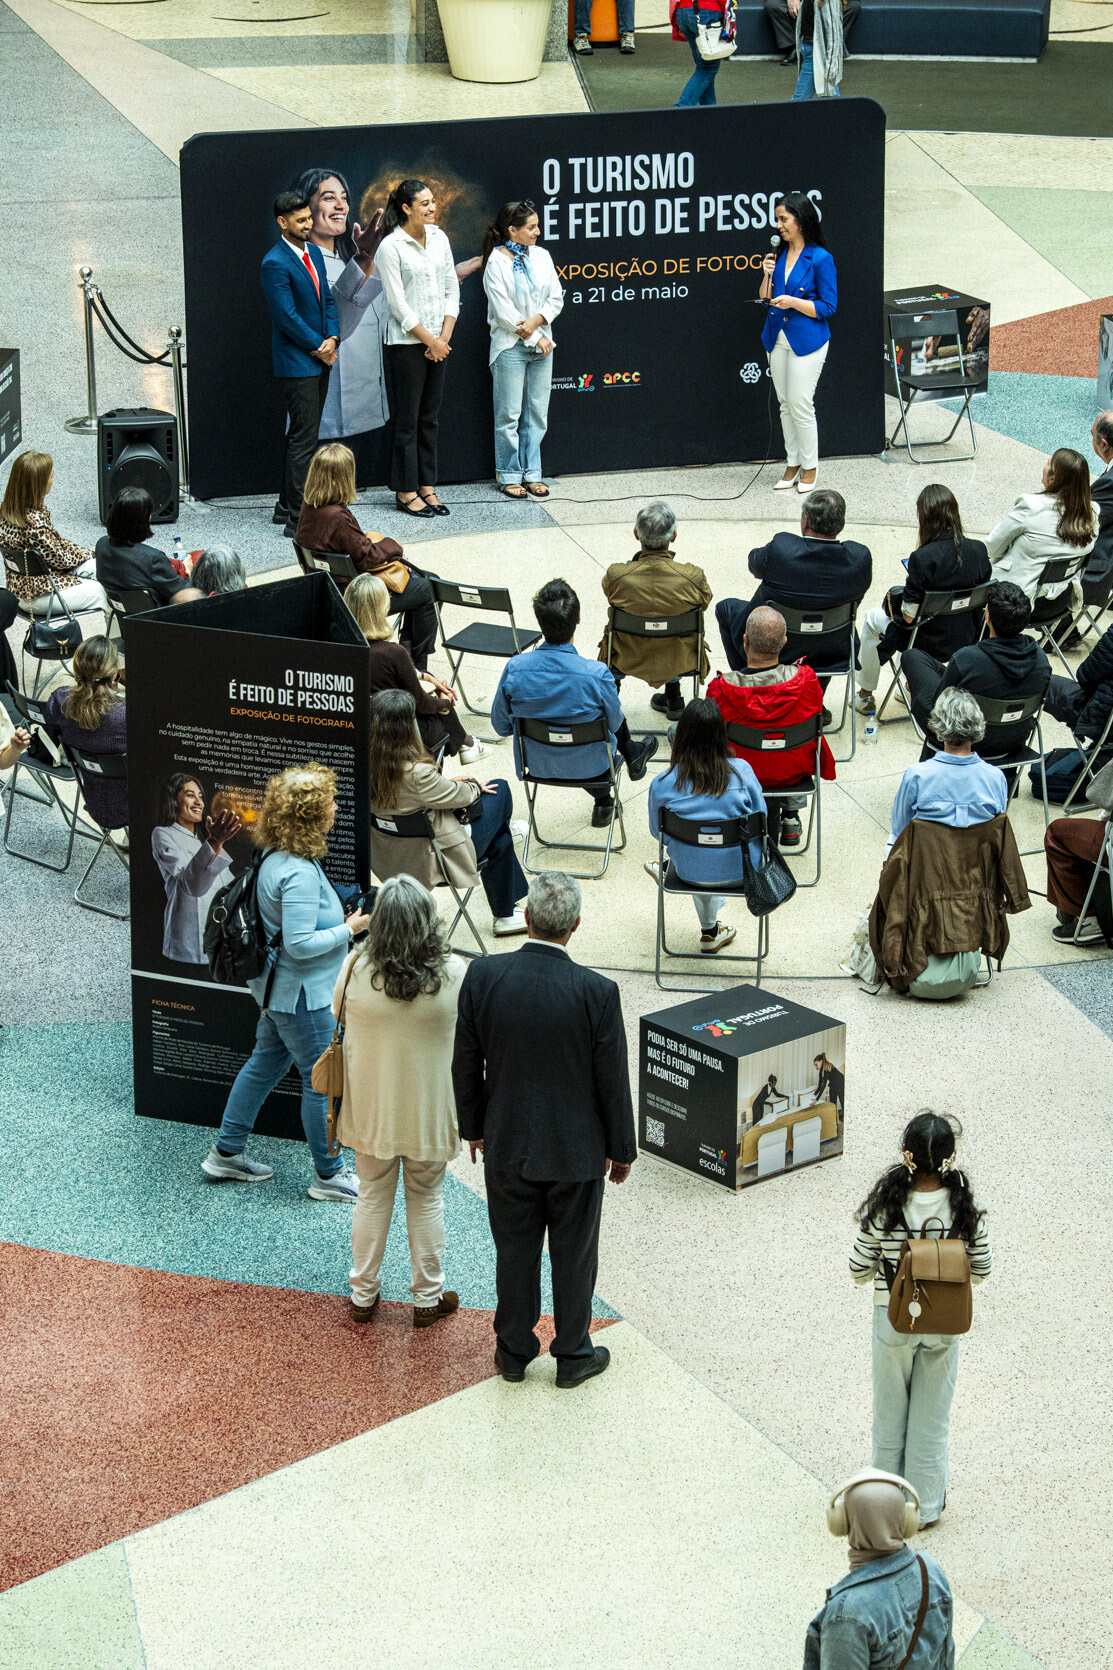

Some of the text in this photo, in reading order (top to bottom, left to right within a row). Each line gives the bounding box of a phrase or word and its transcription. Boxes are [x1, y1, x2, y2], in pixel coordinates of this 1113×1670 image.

[542, 152, 695, 196] O TURISMO
[543, 190, 822, 240] É FEITO DE PESSOS
[556, 254, 762, 280] XPOSIÇÃO DE FOTOG
[572, 292, 582, 304] a
[588, 287, 605, 303] 21
[611, 286, 636, 301] de
[641, 282, 688, 300] maio
[285, 669, 354, 693] O TURISMO
[229, 679, 354, 713] É FEITO DE PESSOAS
[172, 723, 214, 734] hospitalidade
[230, 707, 354, 729] EXPOSIÇÃO DE FOTOGRAFIA
[168, 730, 193, 739] cuidado
[232, 739, 258, 748] empatia
[333, 750, 355, 759] acolhe
[188, 757, 218, 766] exposição
[241, 763, 281, 773] homenagem
[209, 750, 240, 759] memórias
[255, 756, 281, 765] levamos
[286, 752, 314, 761] subtileza
[214, 767, 246, 776] verdadeira
[726, 1004, 784, 1023] PORTUGAL
[648, 1030, 665, 1047] PODIA
[666, 1038, 678, 1052] SER
[679, 1043, 687, 1056] SÓ
[688, 1048, 701, 1063] UMA
[647, 1046, 695, 1076] MAS É O FUTURO
[647, 1062, 689, 1090] A ACONTECER!
[699, 1158, 726, 1176] escolas
